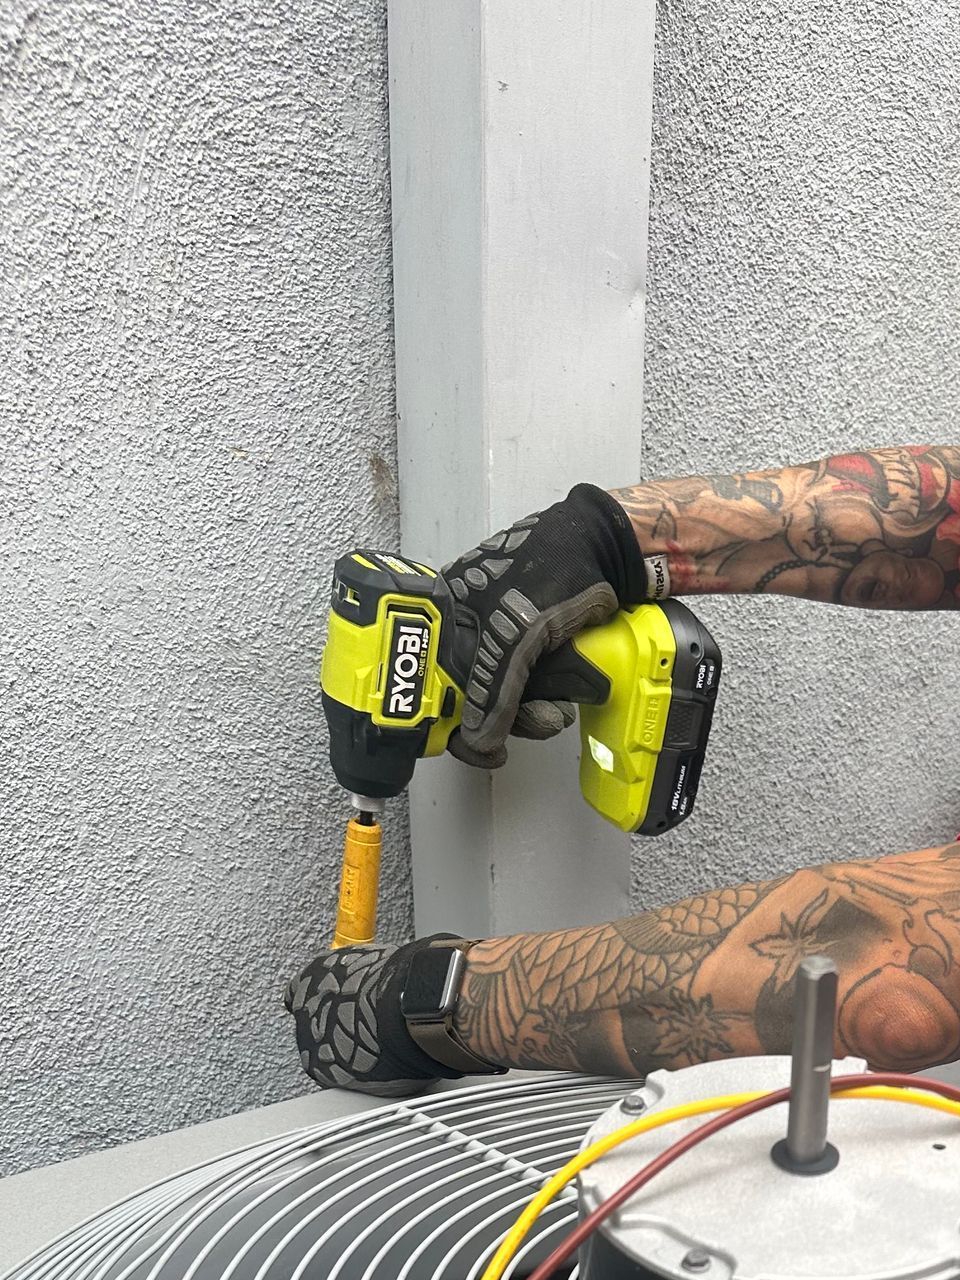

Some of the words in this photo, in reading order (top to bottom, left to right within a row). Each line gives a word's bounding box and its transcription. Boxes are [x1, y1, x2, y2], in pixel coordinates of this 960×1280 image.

[422, 628, 429, 649] HP
[389, 626, 423, 713] RYOBI
[696, 665, 706, 689] RYOBI
